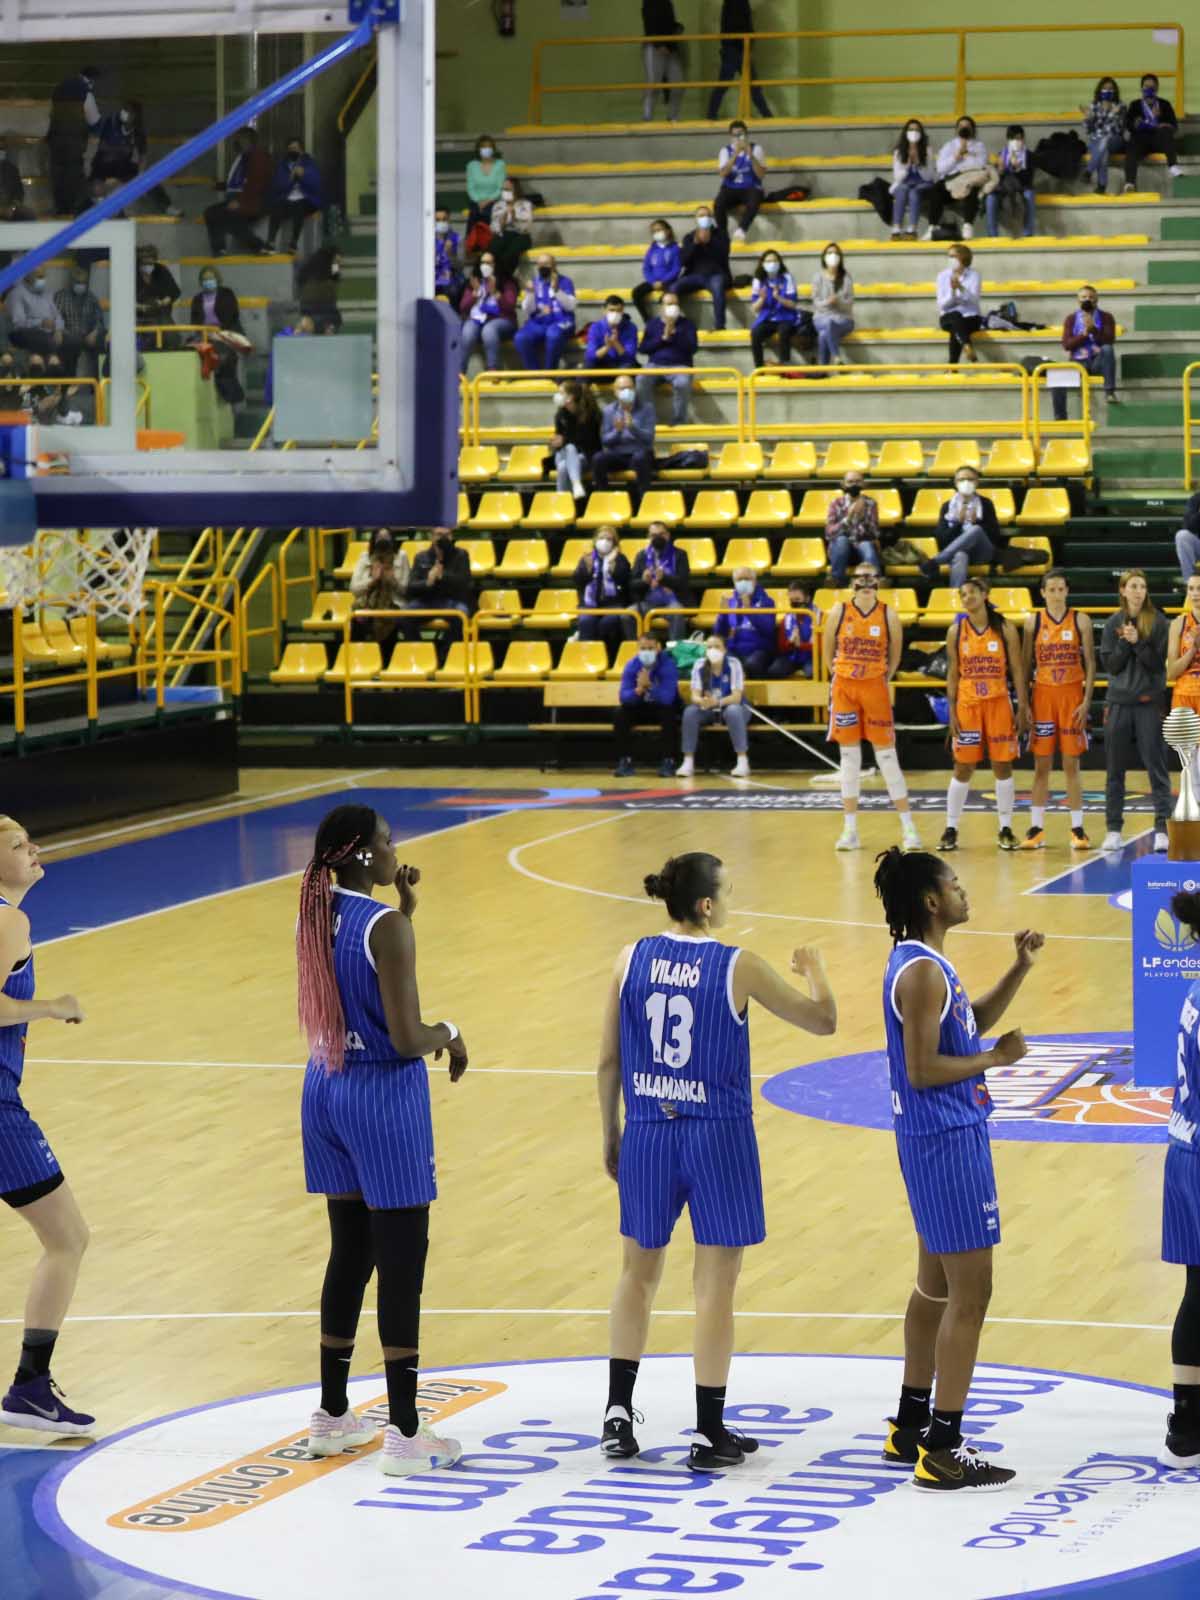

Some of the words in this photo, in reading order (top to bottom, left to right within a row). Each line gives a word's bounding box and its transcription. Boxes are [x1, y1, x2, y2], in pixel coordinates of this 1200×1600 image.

[975, 681, 989, 697] 18
[1051, 668, 1067, 682] 17
[650, 957, 702, 989] VILARÓ
[1142, 957, 1162, 968] LF
[645, 991, 694, 1069] 13
[633, 1071, 707, 1104] SALAMANCA
[415, 1380, 489, 1405] tu
[354, 1418, 602, 1513] .com
[127, 1463, 294, 1527] online
